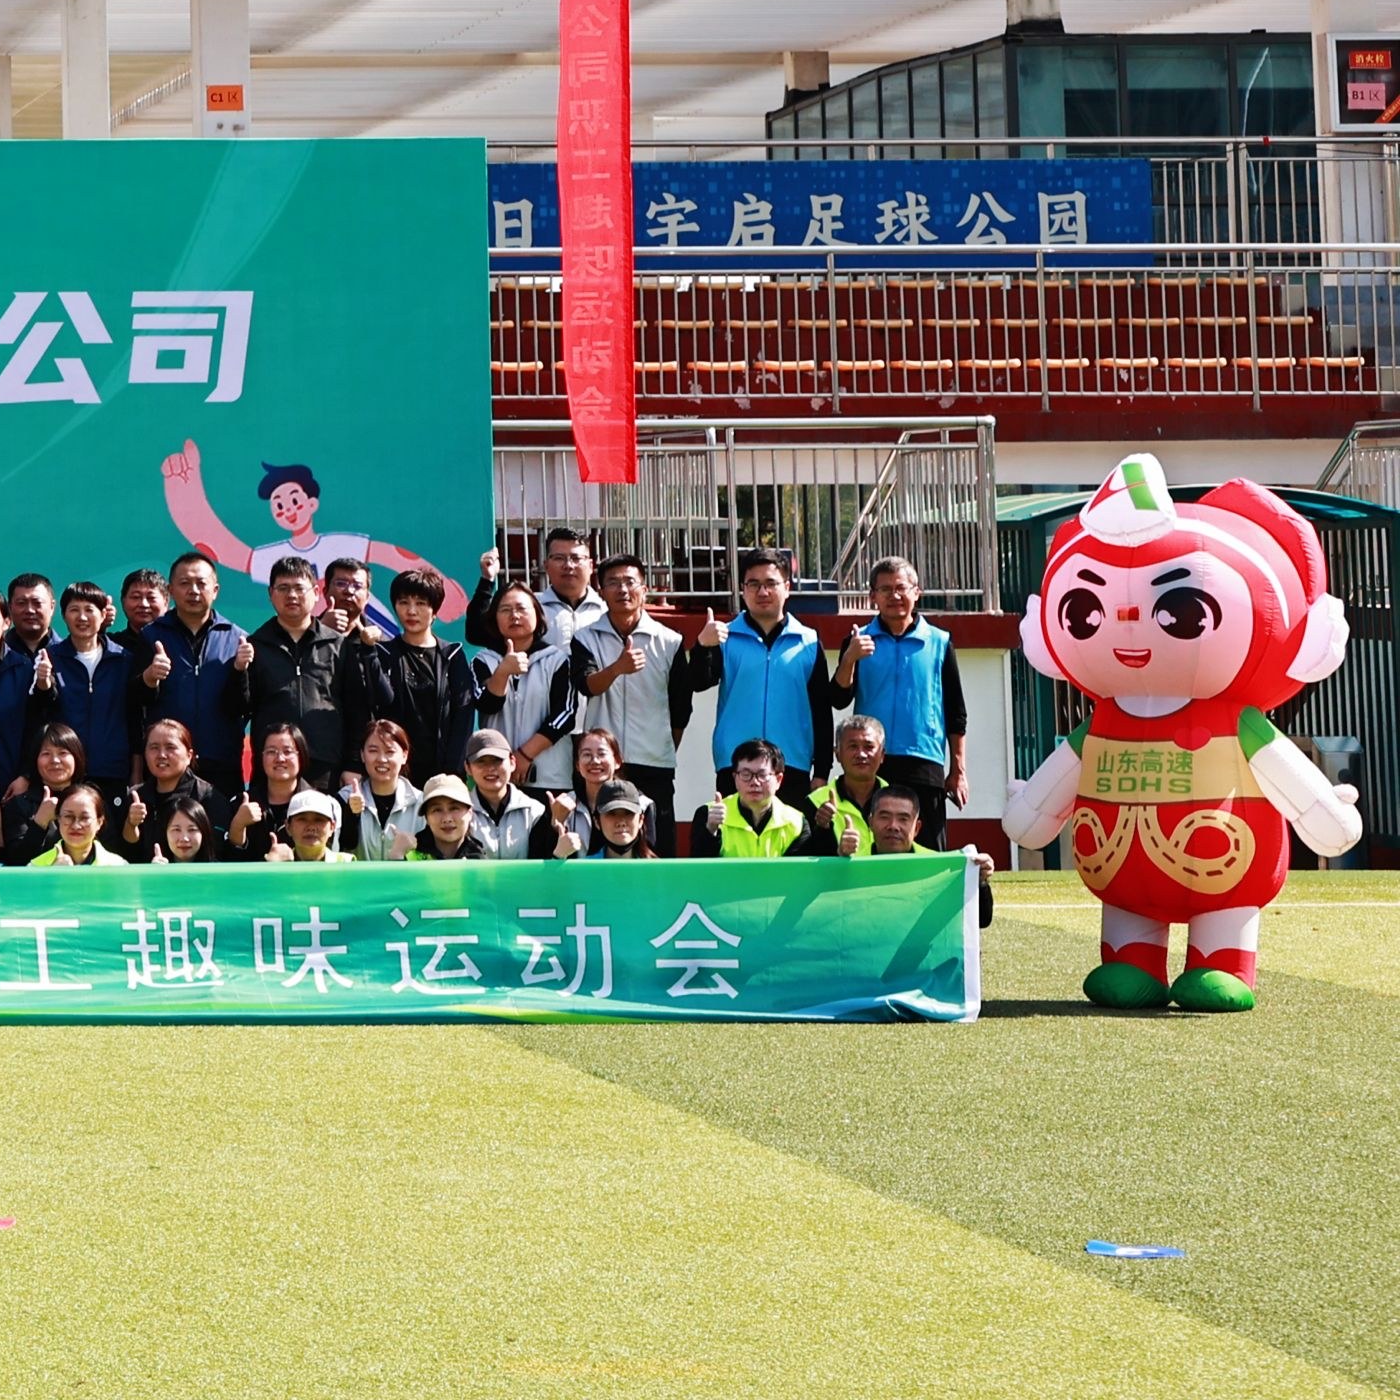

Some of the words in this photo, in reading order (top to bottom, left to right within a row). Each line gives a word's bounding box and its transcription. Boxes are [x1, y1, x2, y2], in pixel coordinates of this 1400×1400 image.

[210, 92, 224, 103] C1
[1352, 90, 1365, 101] B1
[493, 188, 1088, 246] 日宇启足球公园
[1096, 749, 1193, 775] 山东高速
[1096, 776, 1192, 794] SDHS
